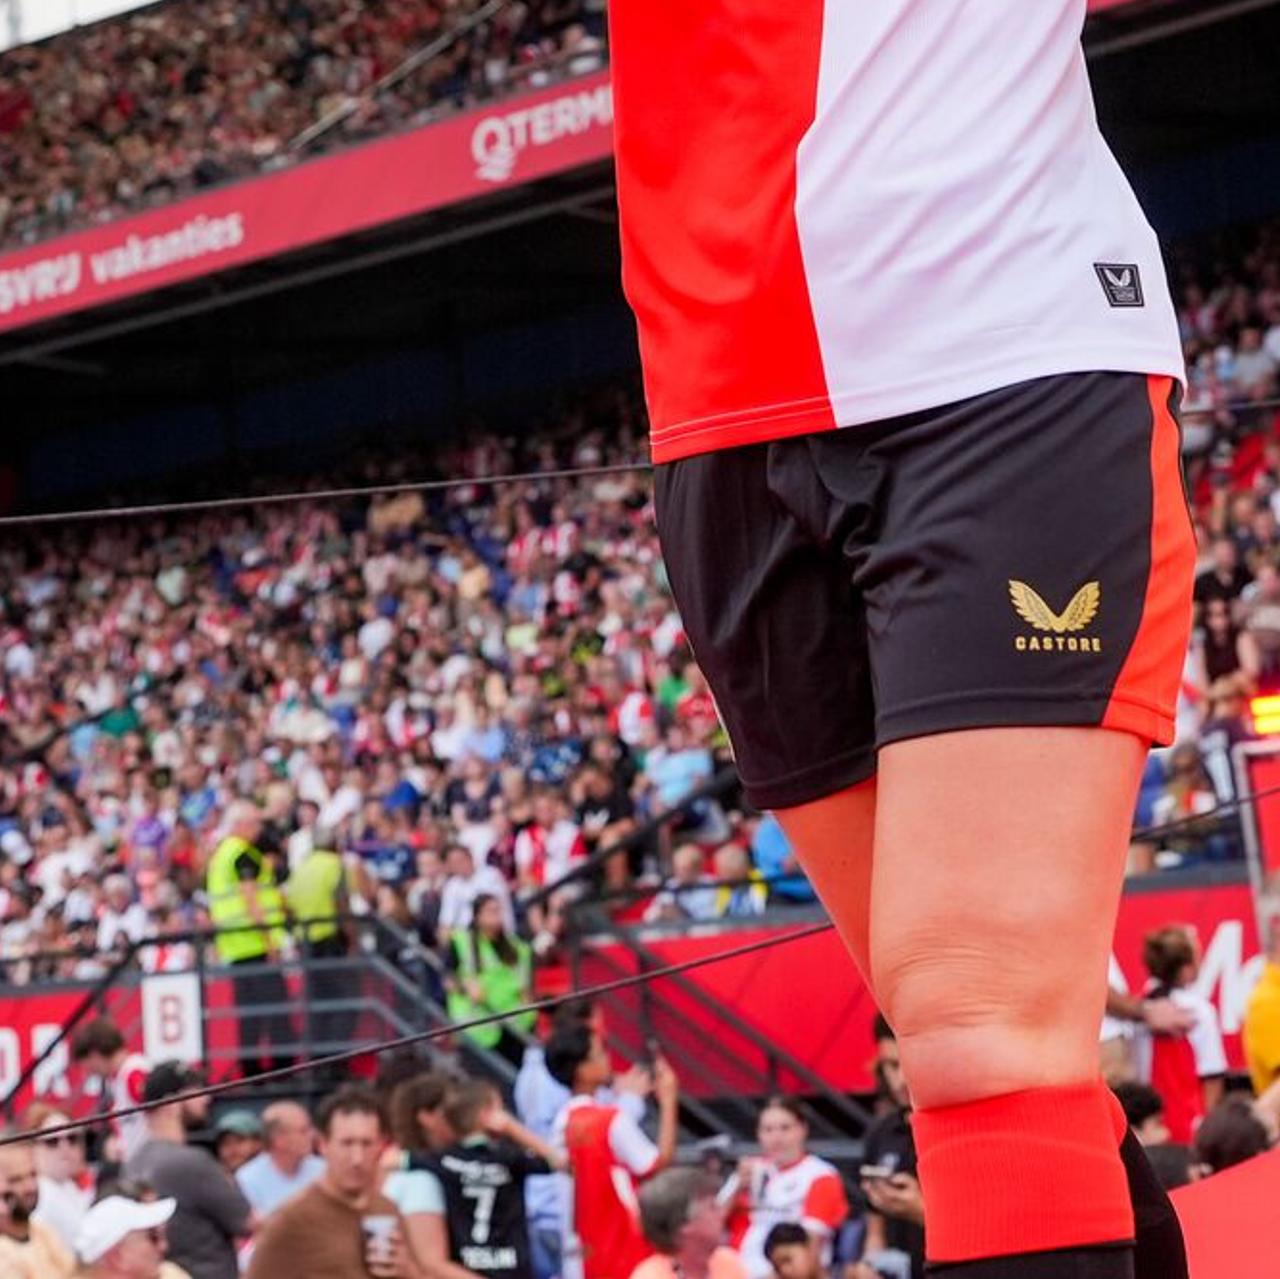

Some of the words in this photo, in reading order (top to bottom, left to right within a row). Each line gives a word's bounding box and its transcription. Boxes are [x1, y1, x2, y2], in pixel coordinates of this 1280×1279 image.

[471, 81, 614, 181] QTERM
[1014, 635, 1102, 652] CASTORE
[462, 1186, 497, 1244] 7
